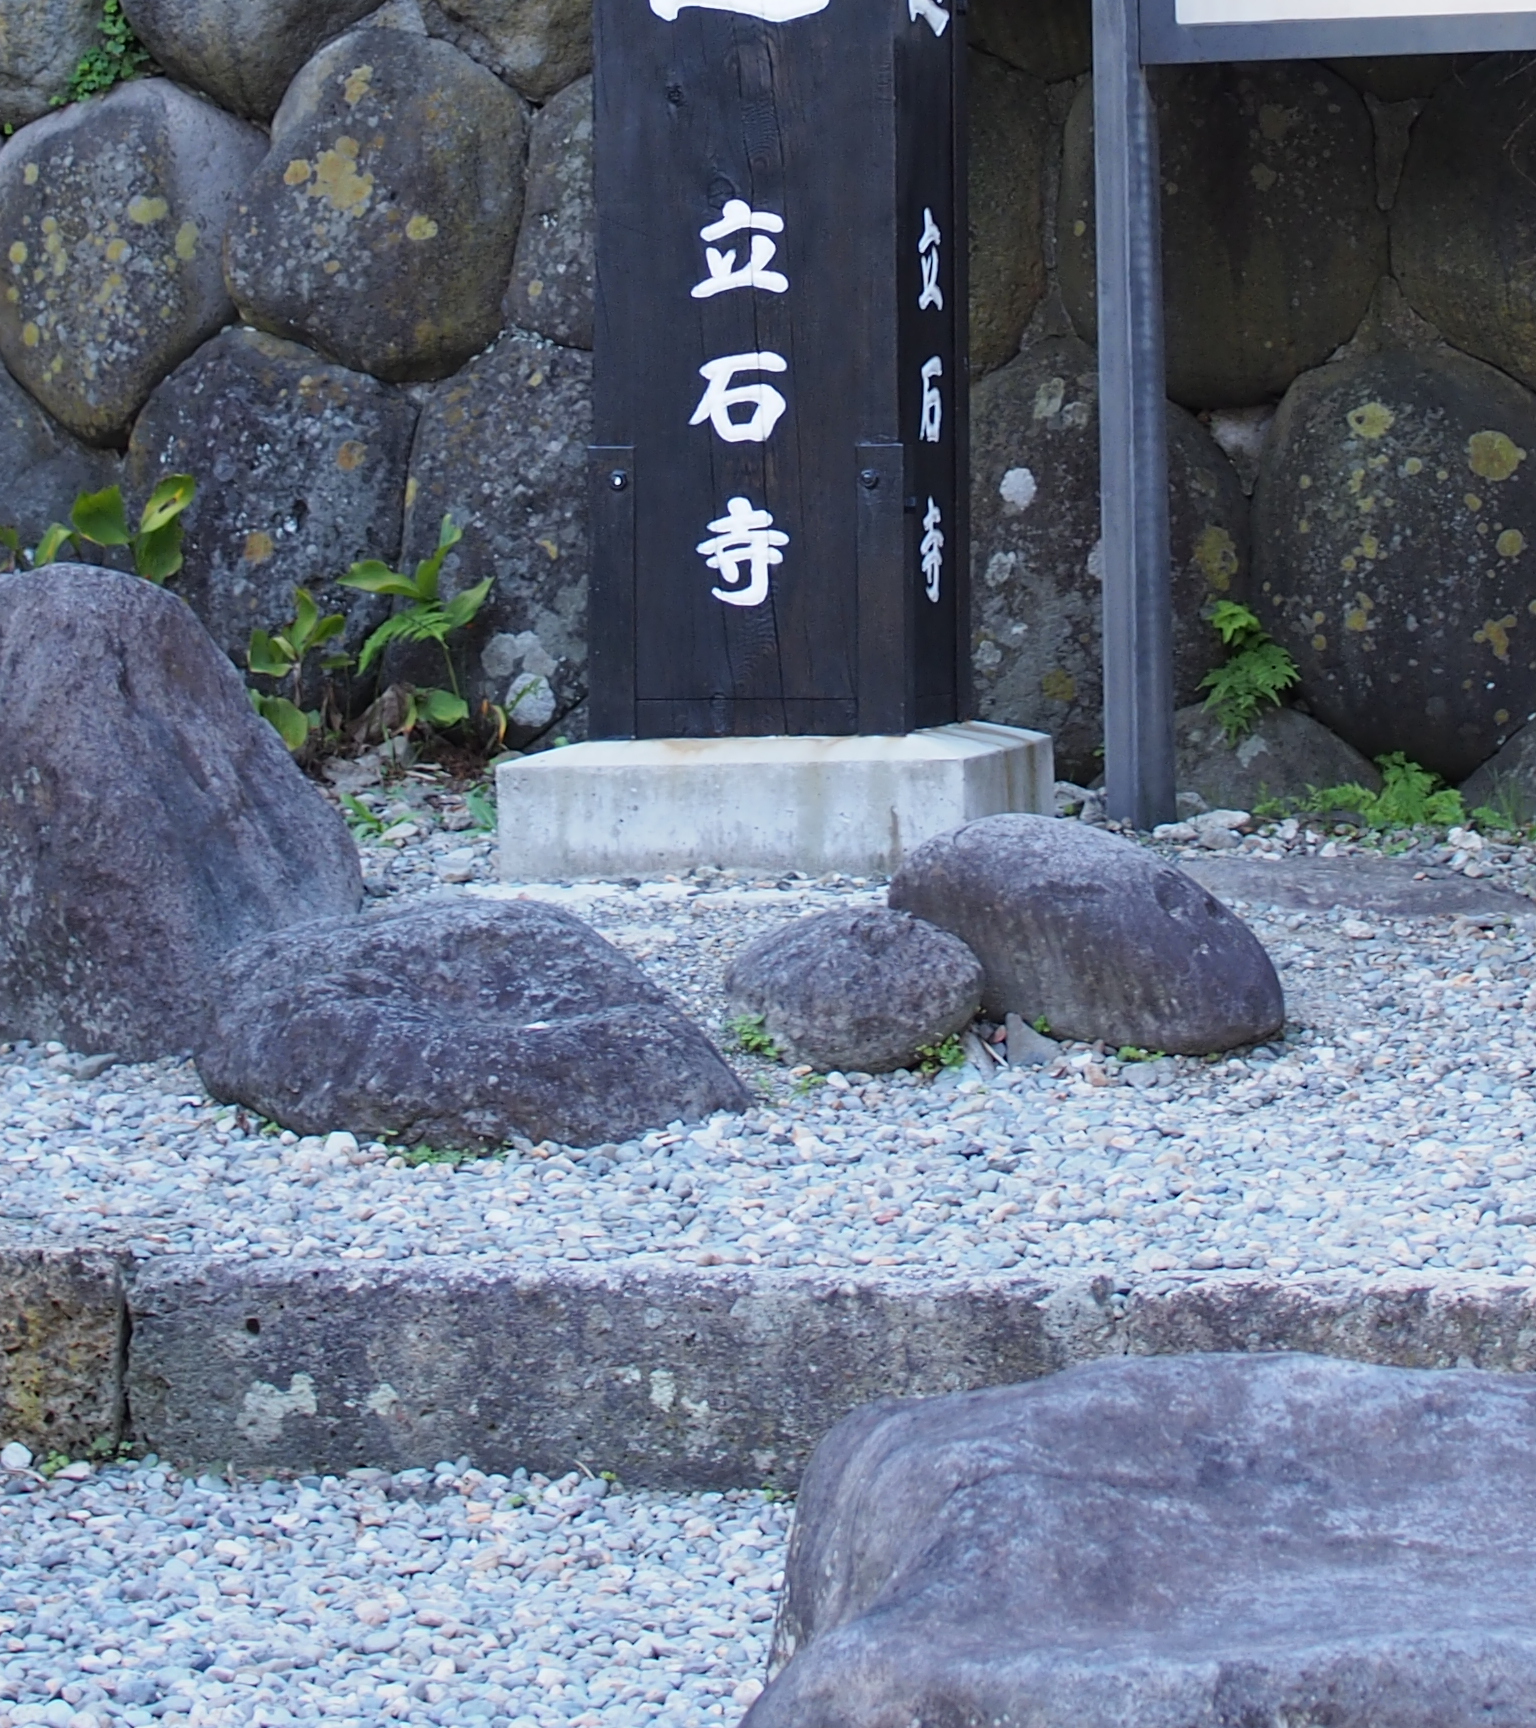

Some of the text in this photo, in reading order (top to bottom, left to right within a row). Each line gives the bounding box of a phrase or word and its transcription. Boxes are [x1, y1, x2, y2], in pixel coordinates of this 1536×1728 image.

[688, 198, 793, 607] 立石寺
[915, 208, 945, 605] 立石寺
